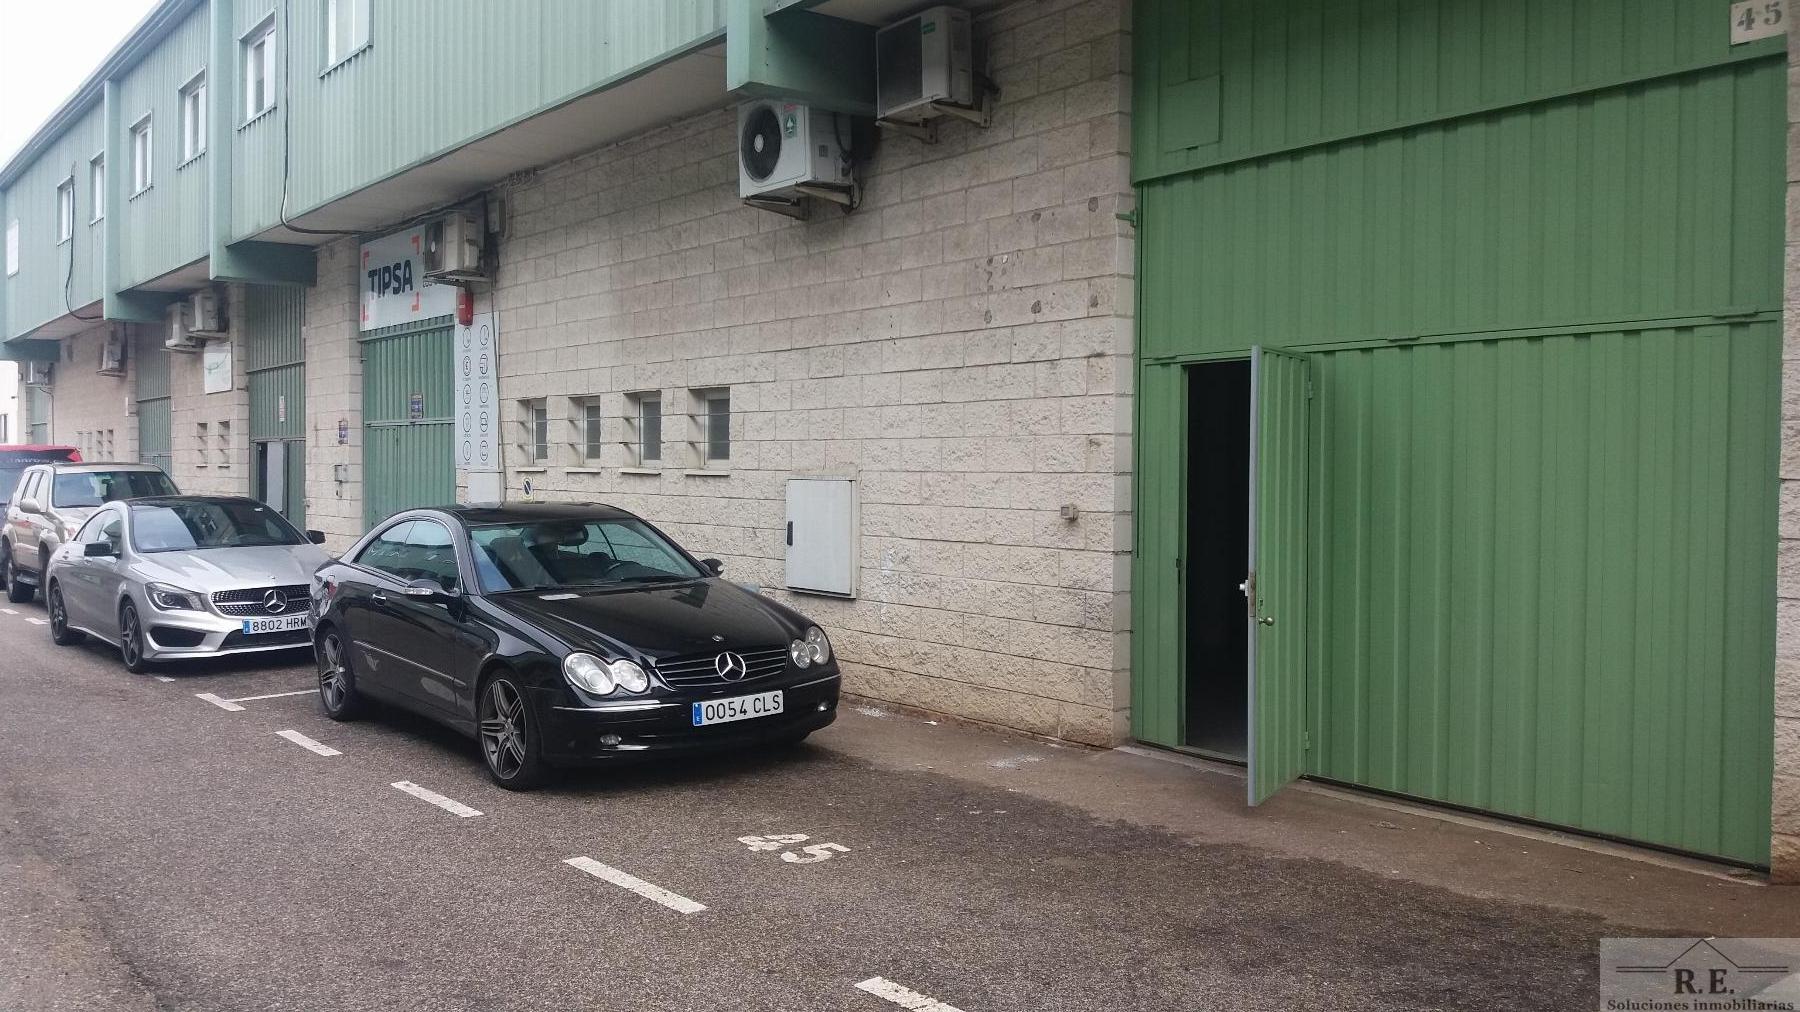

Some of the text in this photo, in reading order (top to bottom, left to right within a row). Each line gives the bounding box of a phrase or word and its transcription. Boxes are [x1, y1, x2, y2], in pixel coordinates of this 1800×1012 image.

[1736, 1, 1782, 31] 45
[367, 259, 414, 298] TIPSA
[252, 616, 307, 632] 8802 HRM
[705, 694, 781, 721] 0054 CLS
[737, 833, 852, 864] 45
